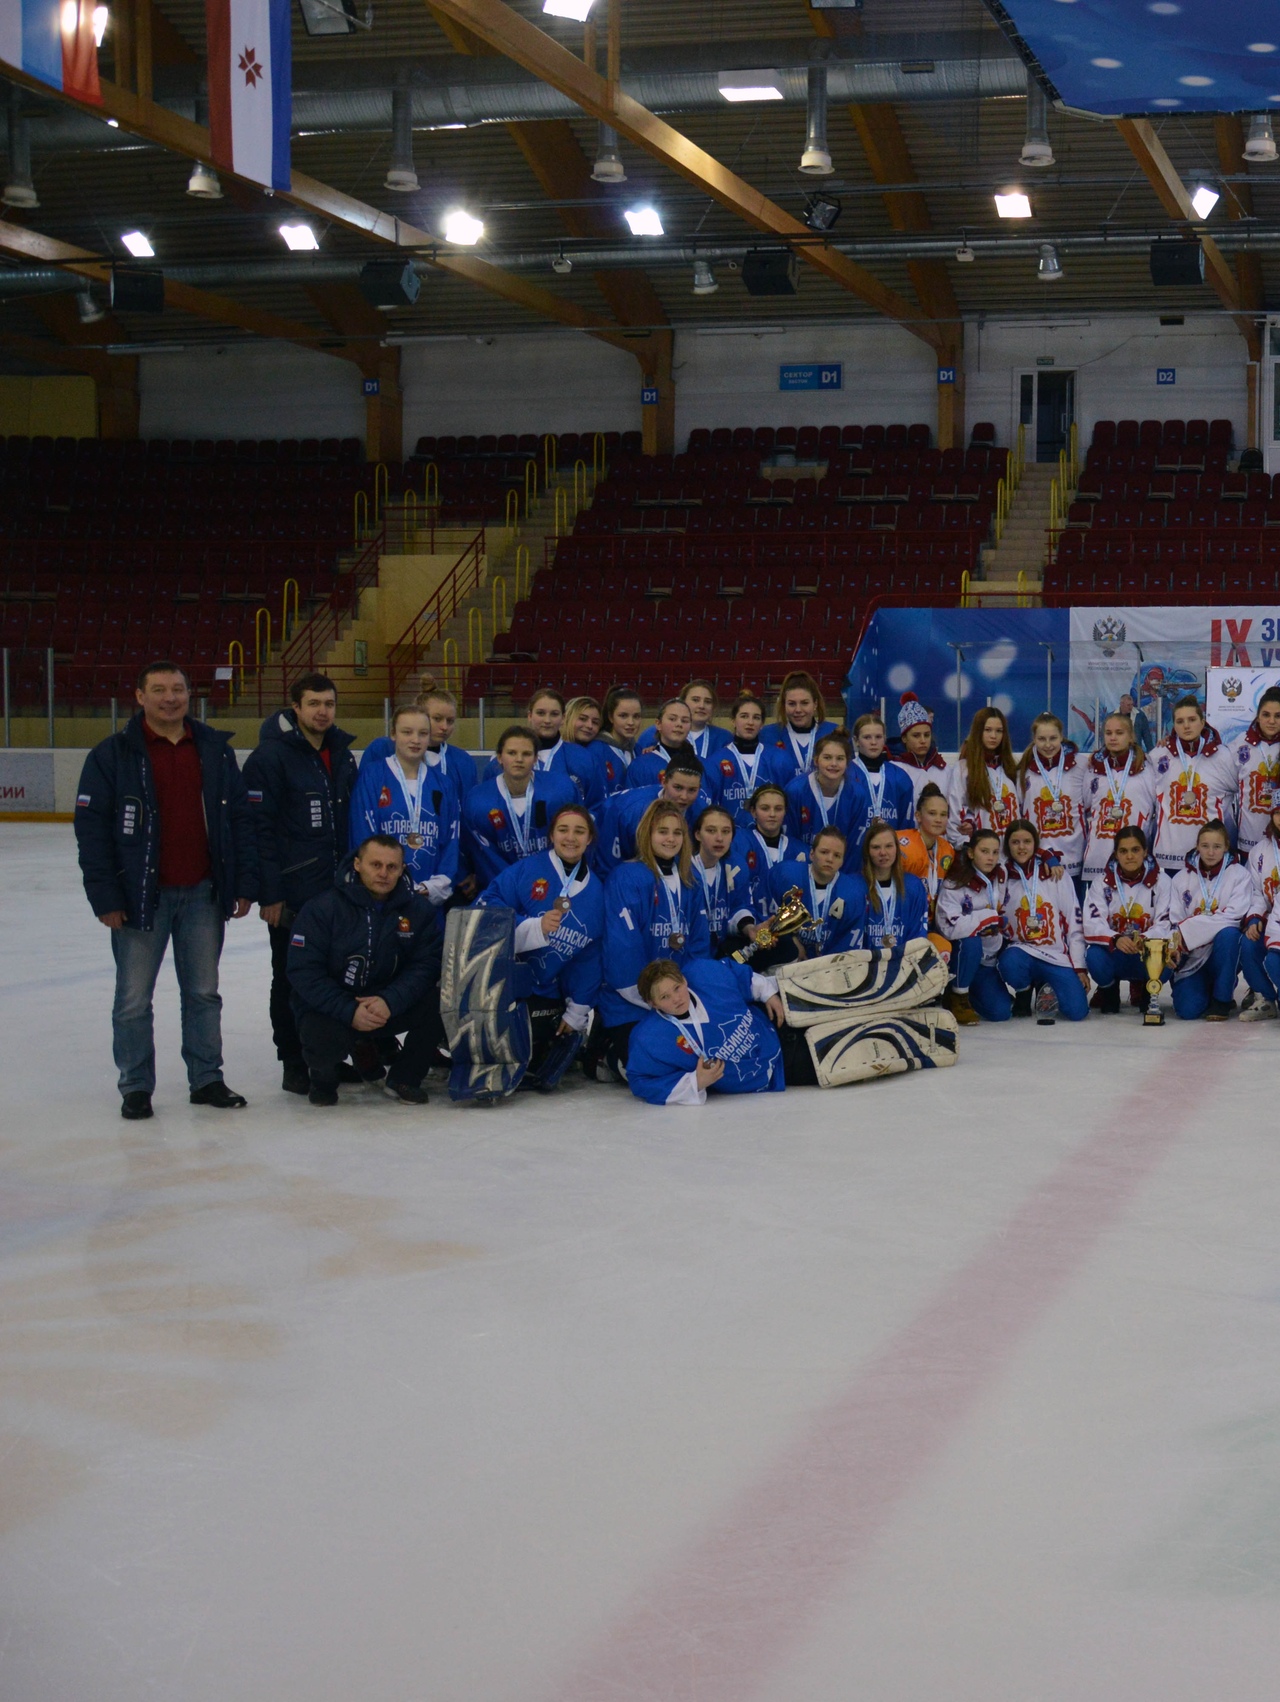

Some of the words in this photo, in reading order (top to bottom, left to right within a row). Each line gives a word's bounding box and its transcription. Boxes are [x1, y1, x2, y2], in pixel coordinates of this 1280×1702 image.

[821, 371, 837, 383] D1
[939, 370, 954, 381] D1
[1158, 372, 1173, 382] D2
[365, 382, 378, 392] D1
[643, 391, 656, 401] D1
[1210, 619, 1253, 667] IX
[612, 836, 622, 858] 6
[1155, 853, 1185, 861] МОСКОВСК
[619, 907, 635, 931] 1
